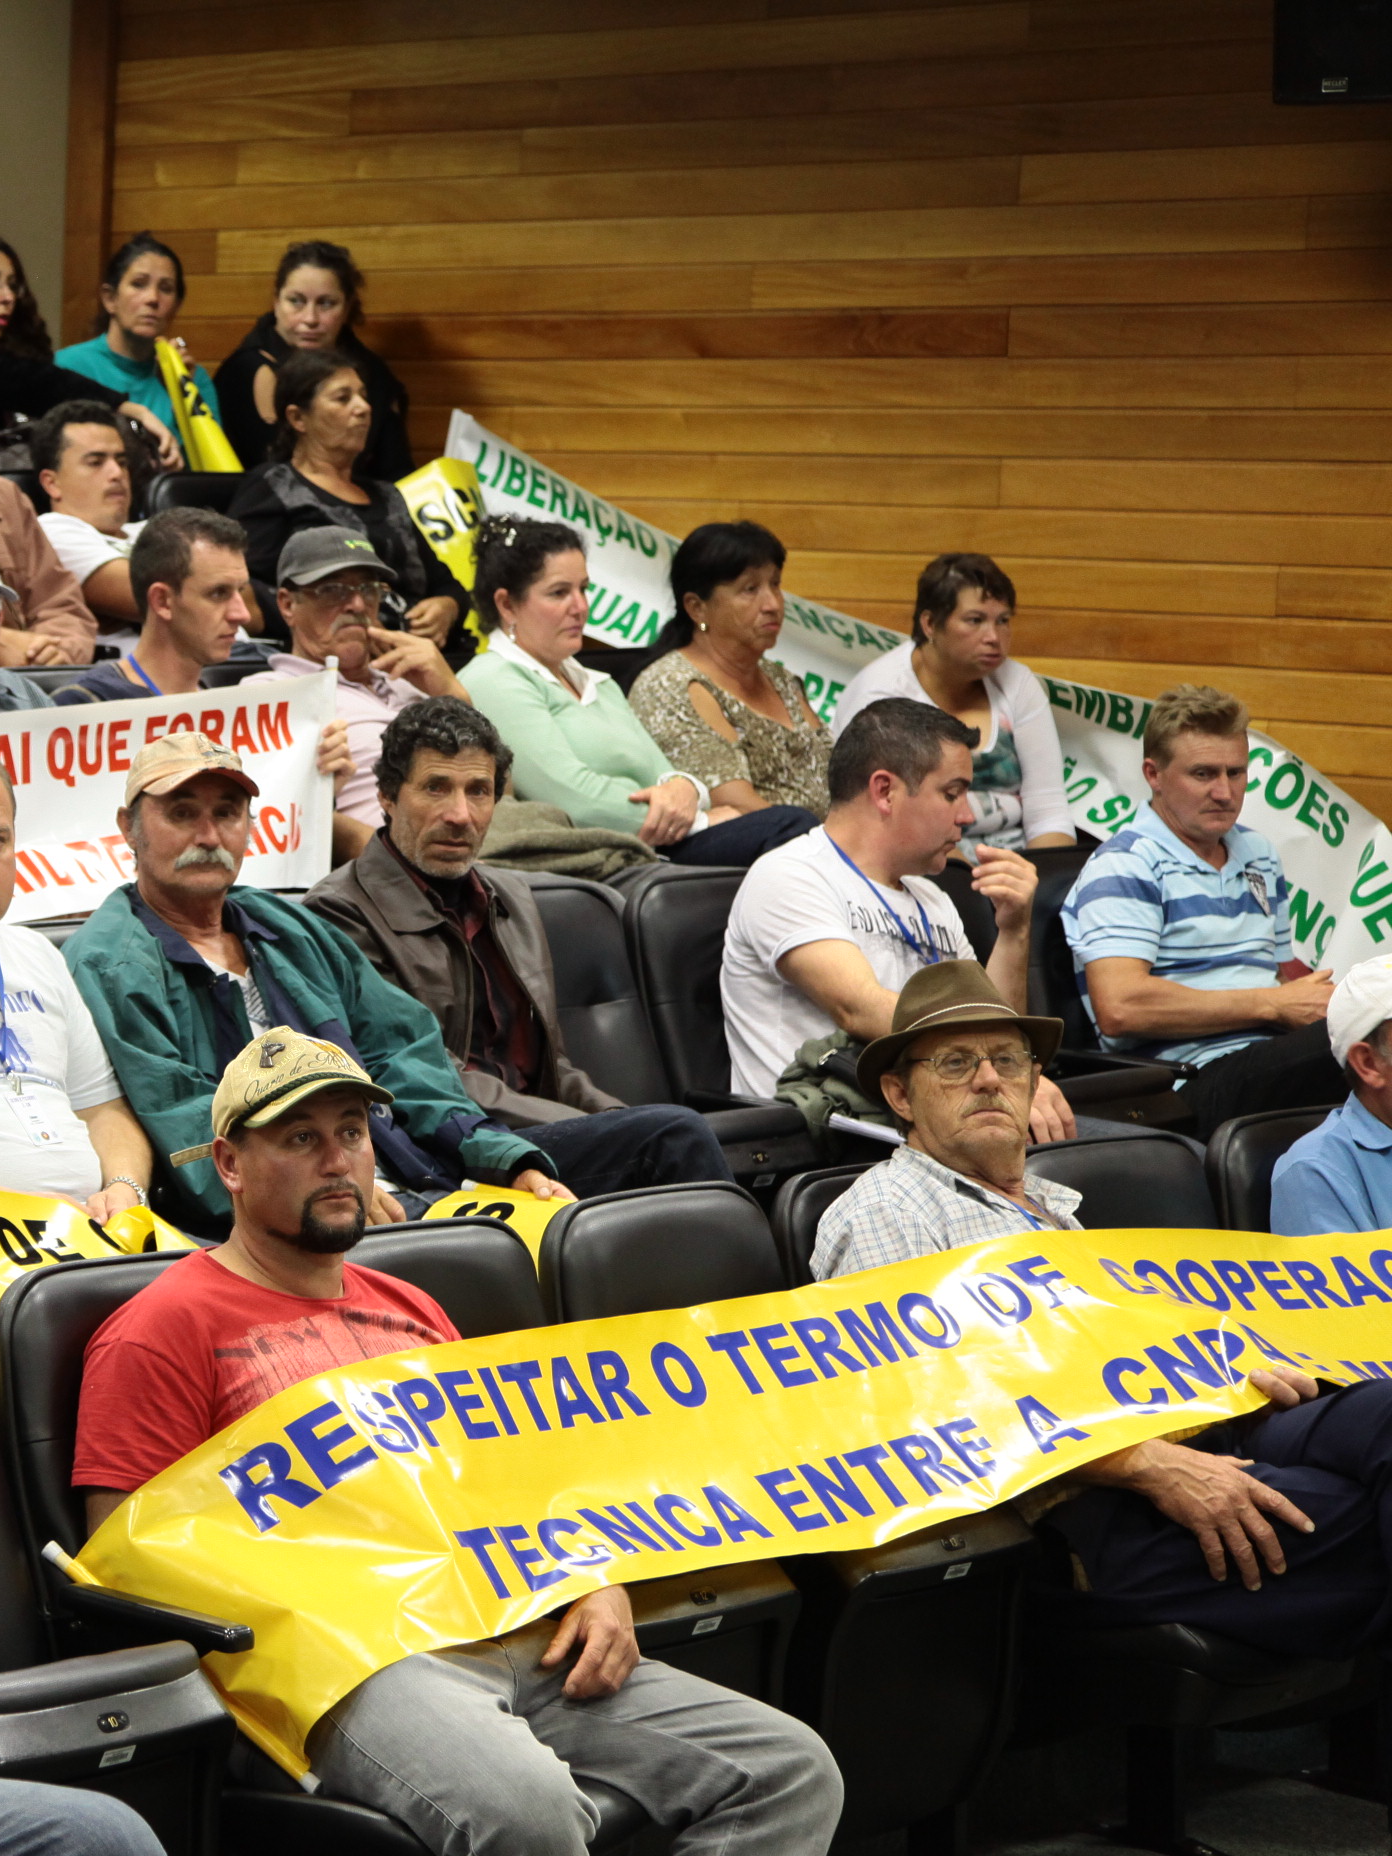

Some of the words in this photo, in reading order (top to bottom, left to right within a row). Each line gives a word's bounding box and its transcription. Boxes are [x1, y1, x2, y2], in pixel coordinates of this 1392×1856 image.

[46, 719, 132, 788] QUE
[218, 1349, 652, 1533] RESPEITAR
[650, 1341, 708, 1409] O
[705, 1292, 961, 1395] TERMO
[453, 1484, 775, 1600] TECNICA
[753, 1416, 998, 1533] ENTRE
[1015, 1394, 1092, 1455] A
[107, 1716, 119, 1728] 10
